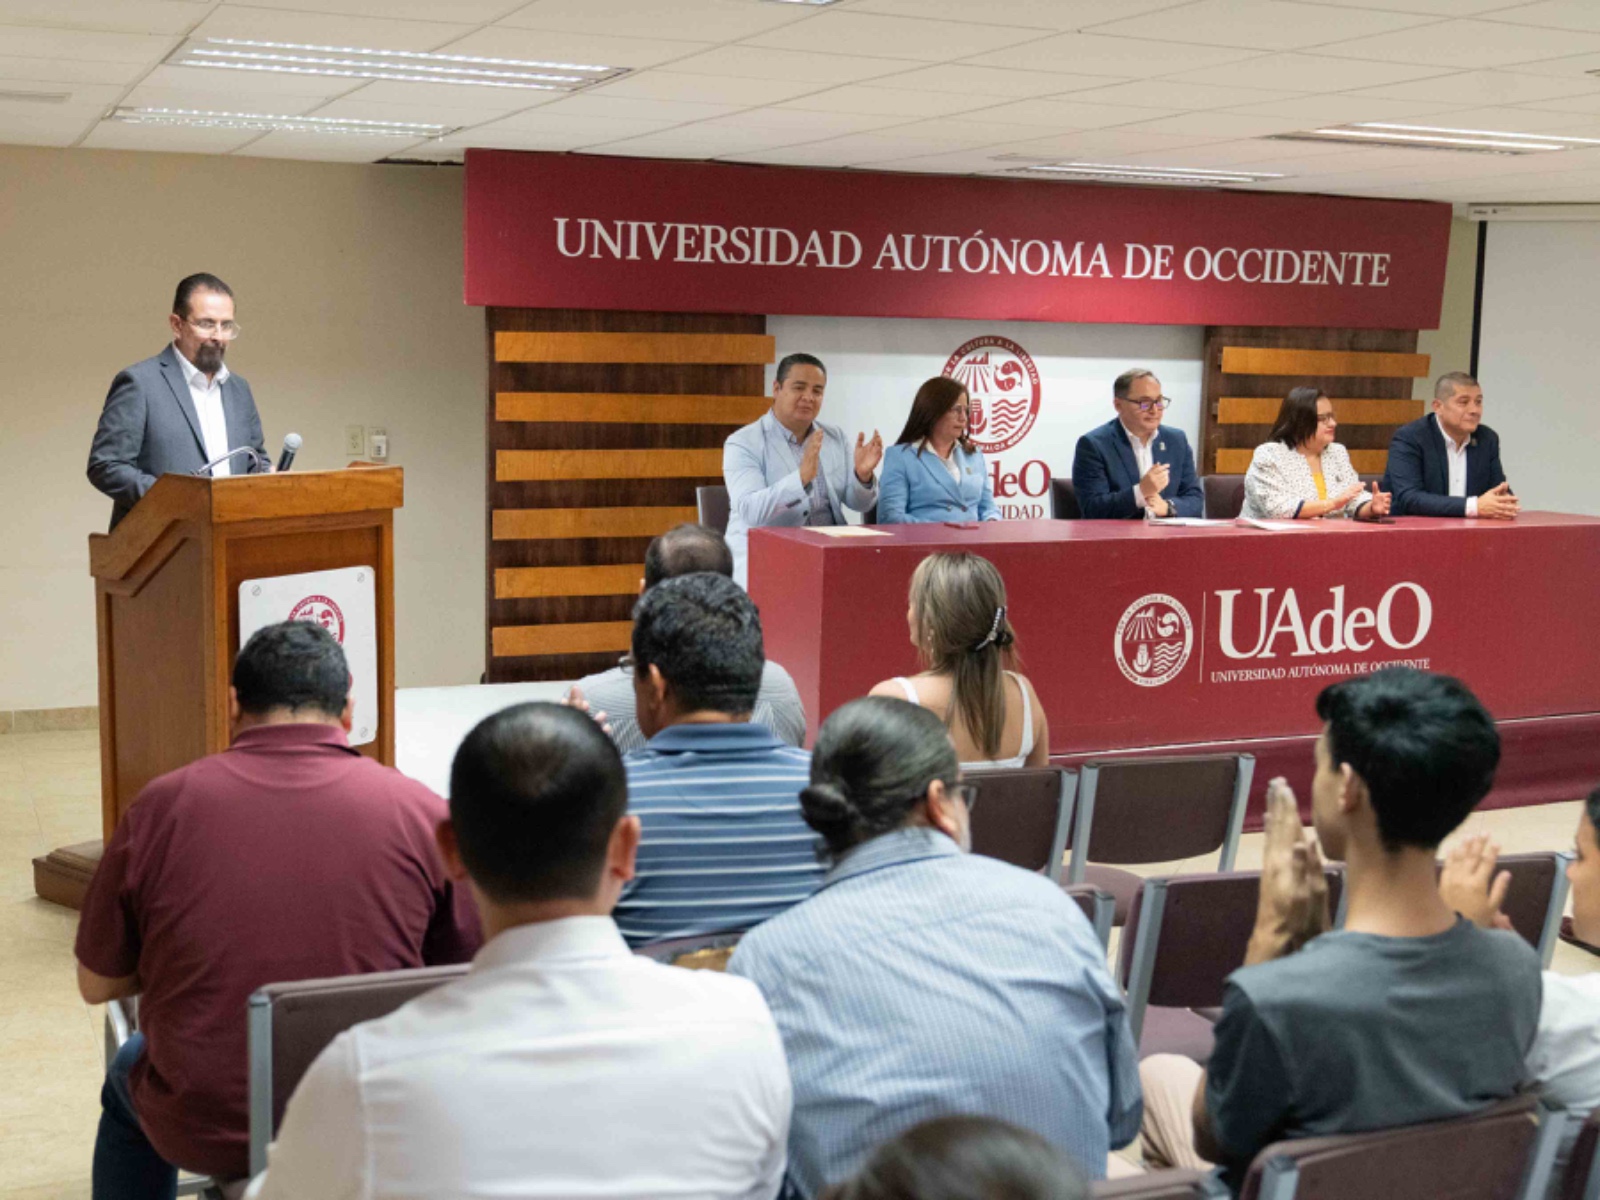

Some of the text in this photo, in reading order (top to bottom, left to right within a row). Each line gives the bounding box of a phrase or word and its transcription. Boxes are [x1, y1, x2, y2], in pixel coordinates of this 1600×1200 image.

[553, 217, 1391, 288] UNIVERSIDAD AUTÓNOMA DE OCCIDENTE
[1214, 581, 1433, 659] UAdeO
[1210, 666, 1286, 683] UNIVERSIDAD
[1288, 663, 1351, 679] AUTÓNOMA
[1354, 661, 1368, 675] DE
